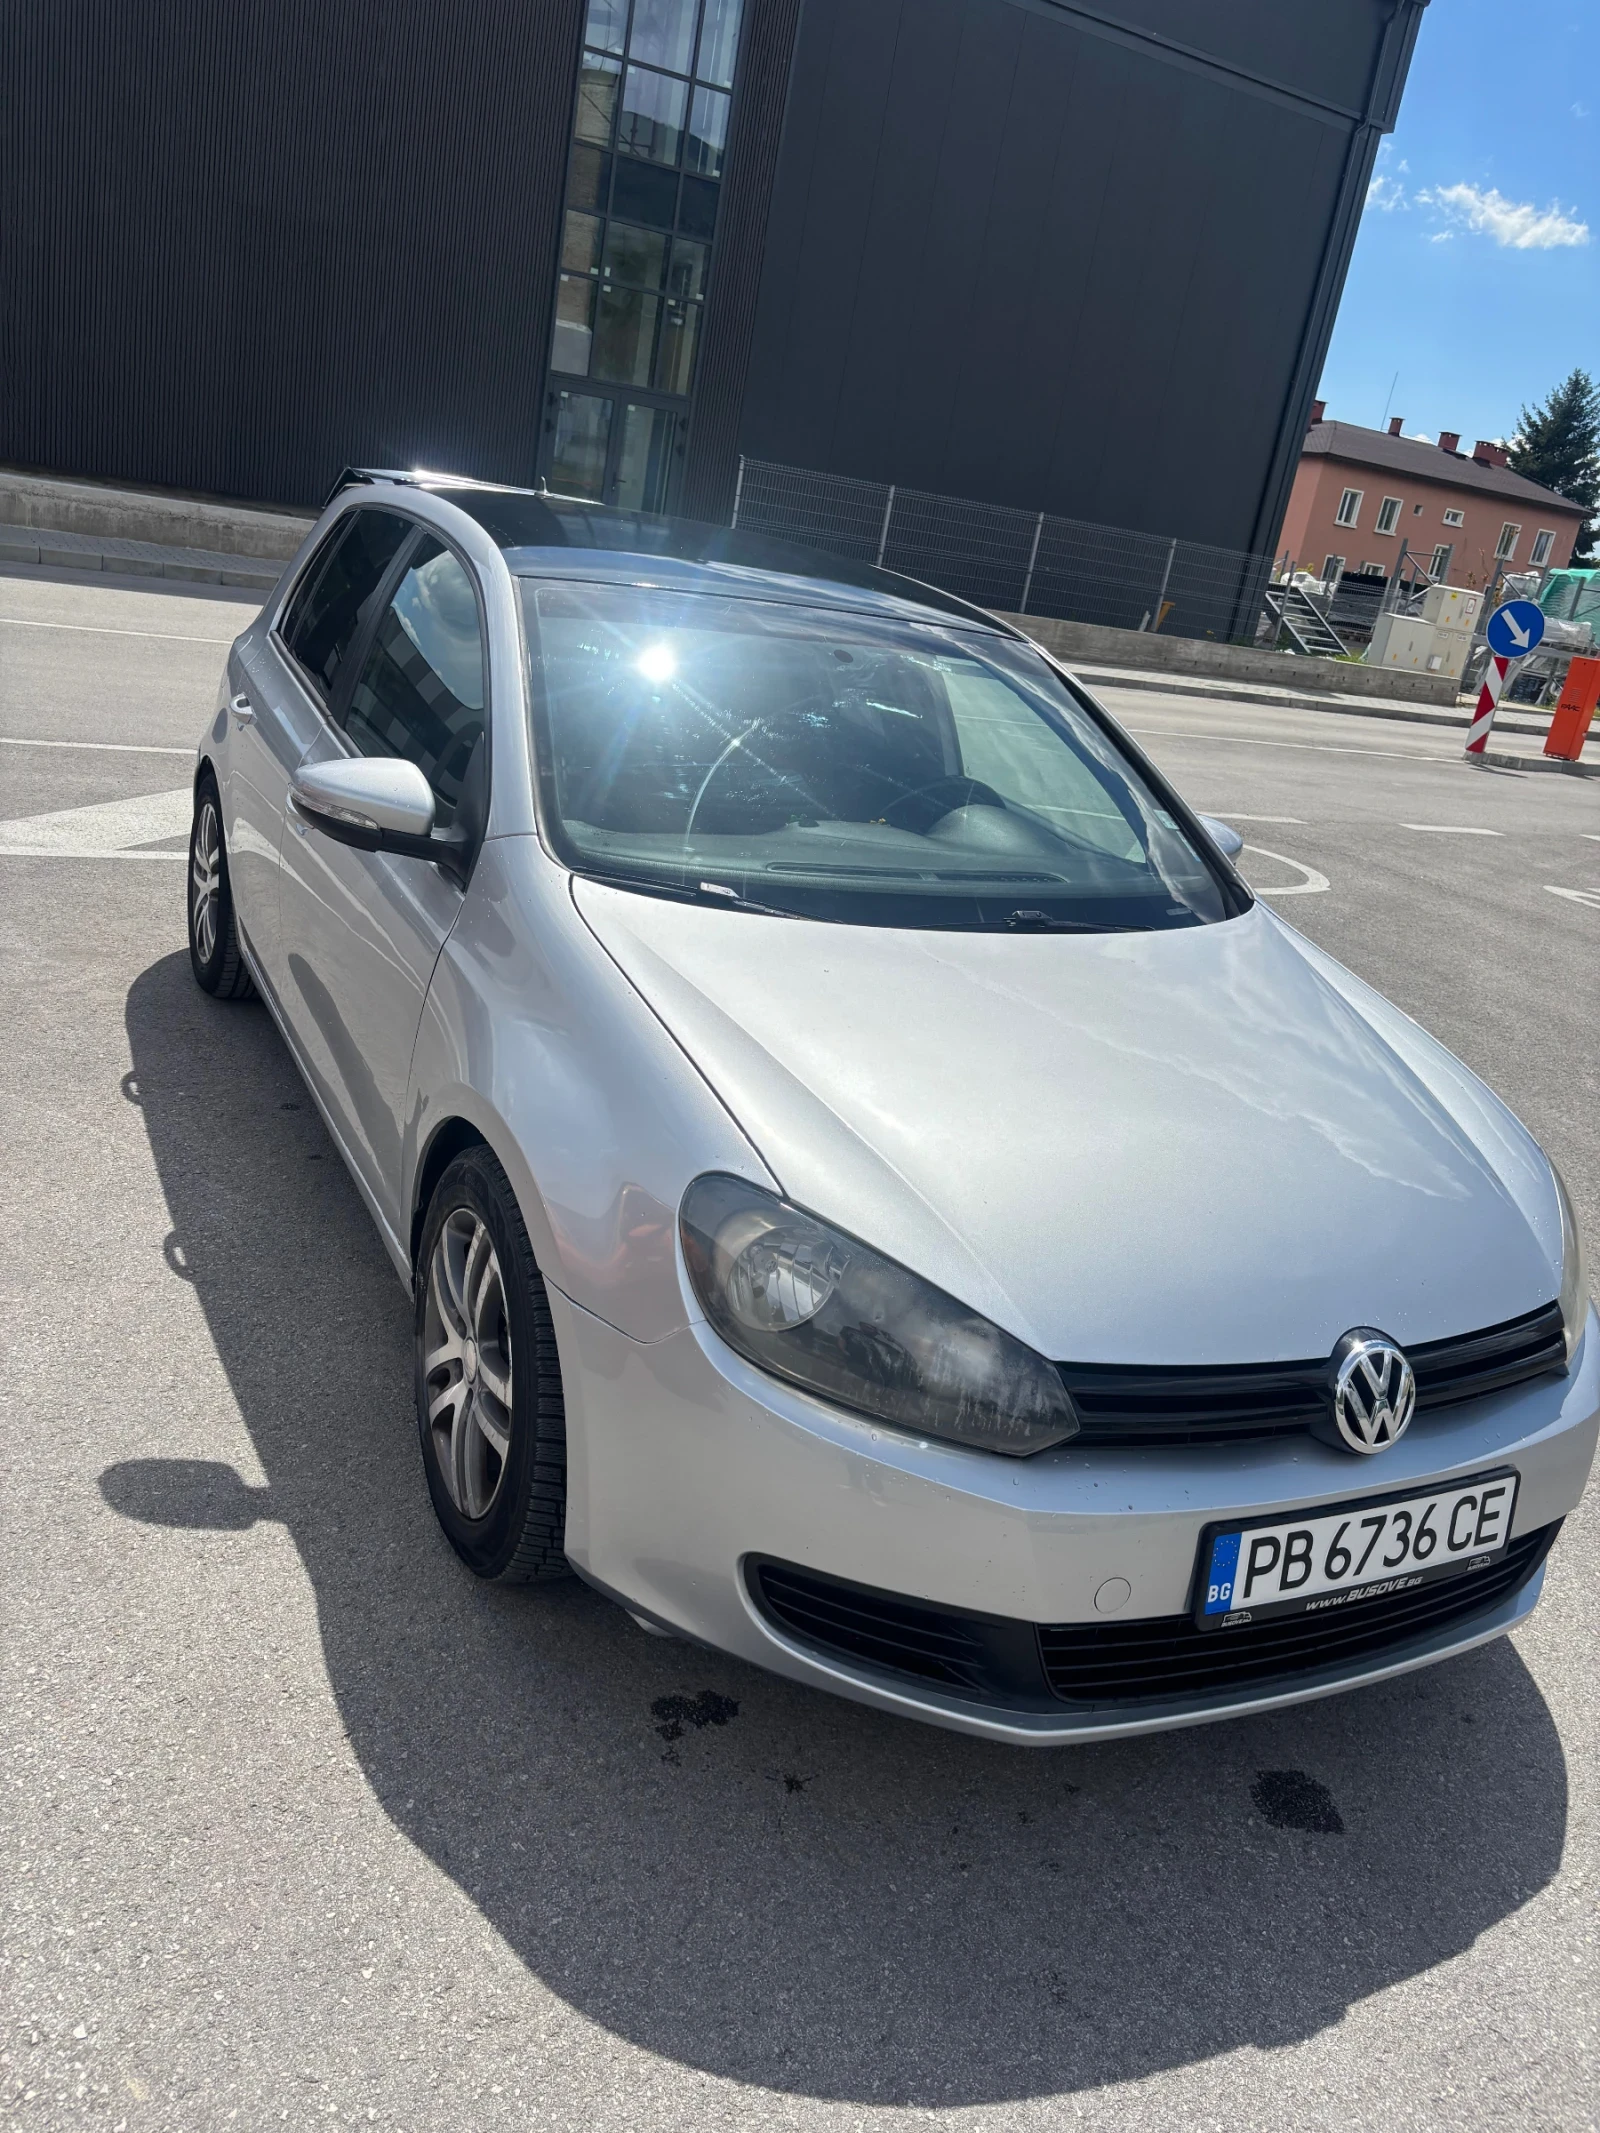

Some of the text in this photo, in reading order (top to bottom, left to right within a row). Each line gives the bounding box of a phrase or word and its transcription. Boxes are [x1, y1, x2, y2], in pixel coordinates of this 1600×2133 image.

[1337, 1343, 1414, 1451] VW
[1207, 1582, 1231, 1603] BG
[1243, 1487, 1507, 1599] PB 6736 CE
